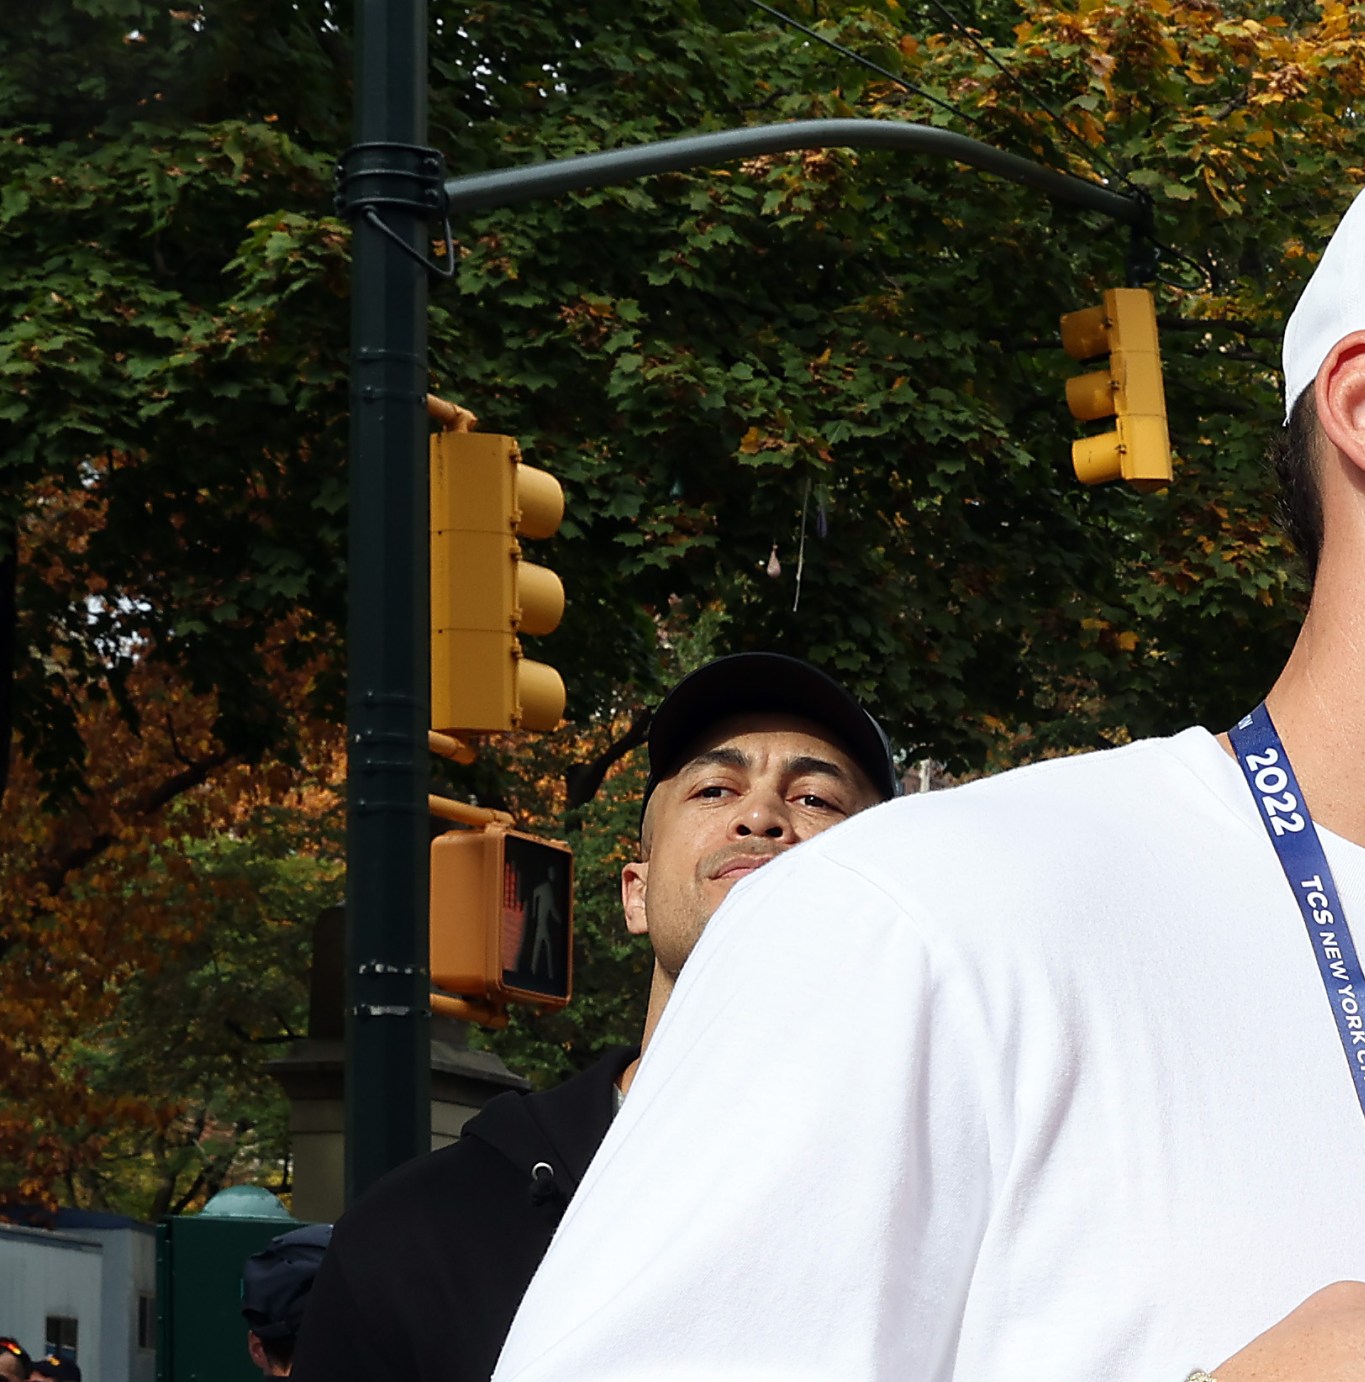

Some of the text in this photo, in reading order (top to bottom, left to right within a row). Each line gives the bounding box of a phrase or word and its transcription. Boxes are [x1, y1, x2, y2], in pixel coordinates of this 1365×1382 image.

[1245, 747, 1306, 837] 2022
[1301, 874, 1334, 925] TCS
[1319, 931, 1350, 981] NEW
